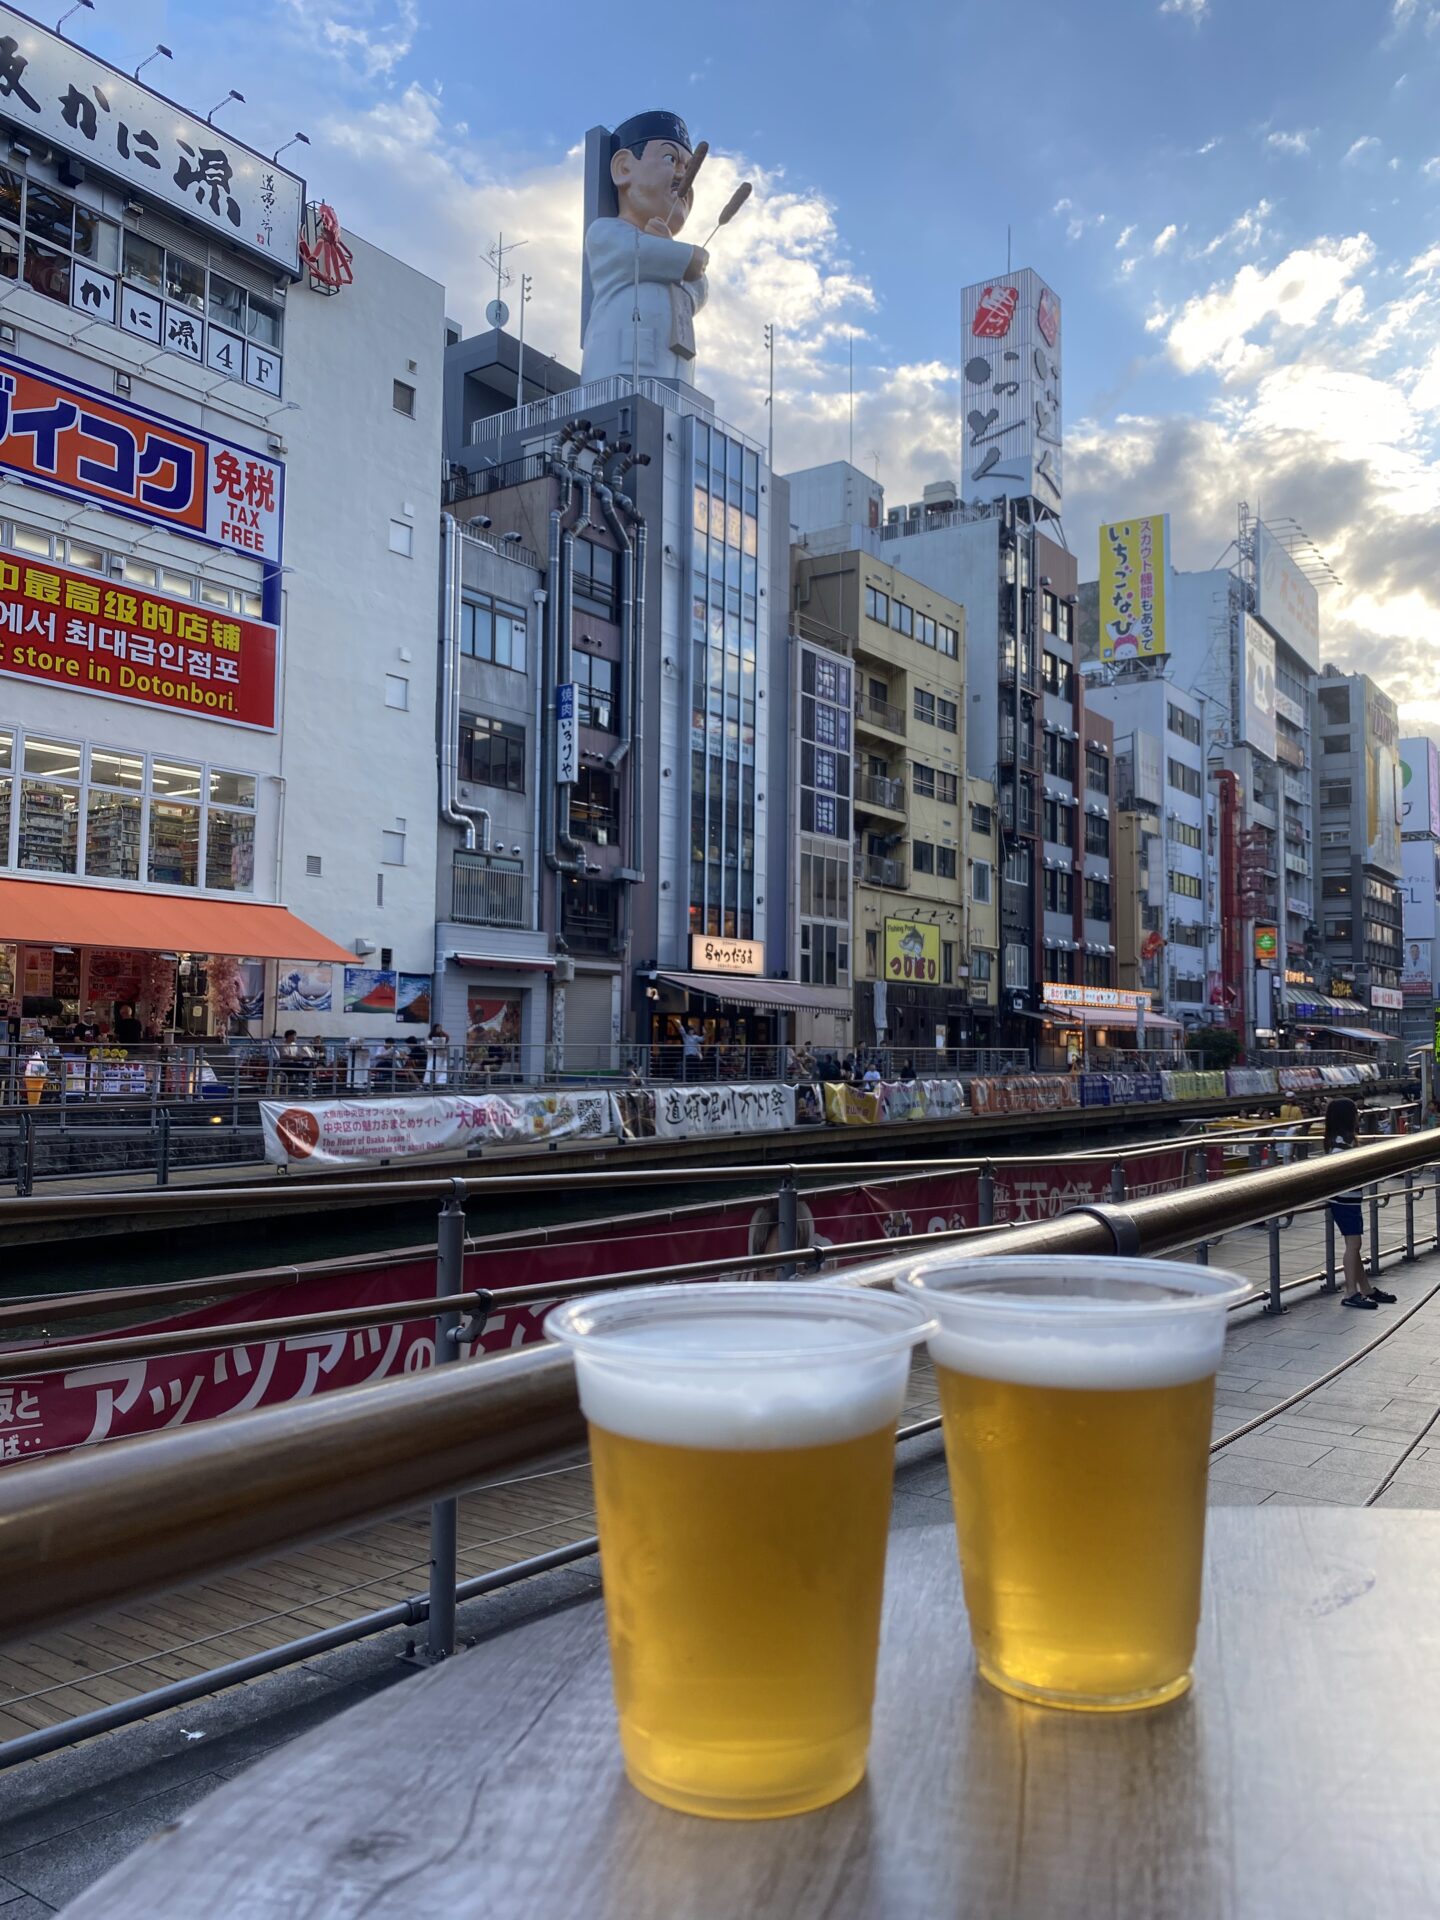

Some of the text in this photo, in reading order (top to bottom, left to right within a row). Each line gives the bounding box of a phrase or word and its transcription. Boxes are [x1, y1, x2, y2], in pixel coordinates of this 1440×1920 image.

[213, 450, 276, 513] 免税
[220, 520, 265, 553] FREE
[226, 501, 260, 530] TAX
[1109, 527, 1136, 636] いちごなび
[0, 601, 240, 684] 에서 최대급인점포
[13, 646, 80, 677] store
[88, 659, 111, 684] in
[119, 666, 239, 713] Dotonbori.
[561, 687, 573, 779] 焼肉 いろりや
[887, 925, 904, 934] Fishing
[322, 1138, 335, 1147] The
[337, 1137, 355, 1147] Heart
[357, 1136, 365, 1145] of
[366, 1135, 385, 1145] Osaka
[386, 1135, 405, 1144] Japan
[323, 1117, 441, 1134] 中央区の魅力おまとめサイト
